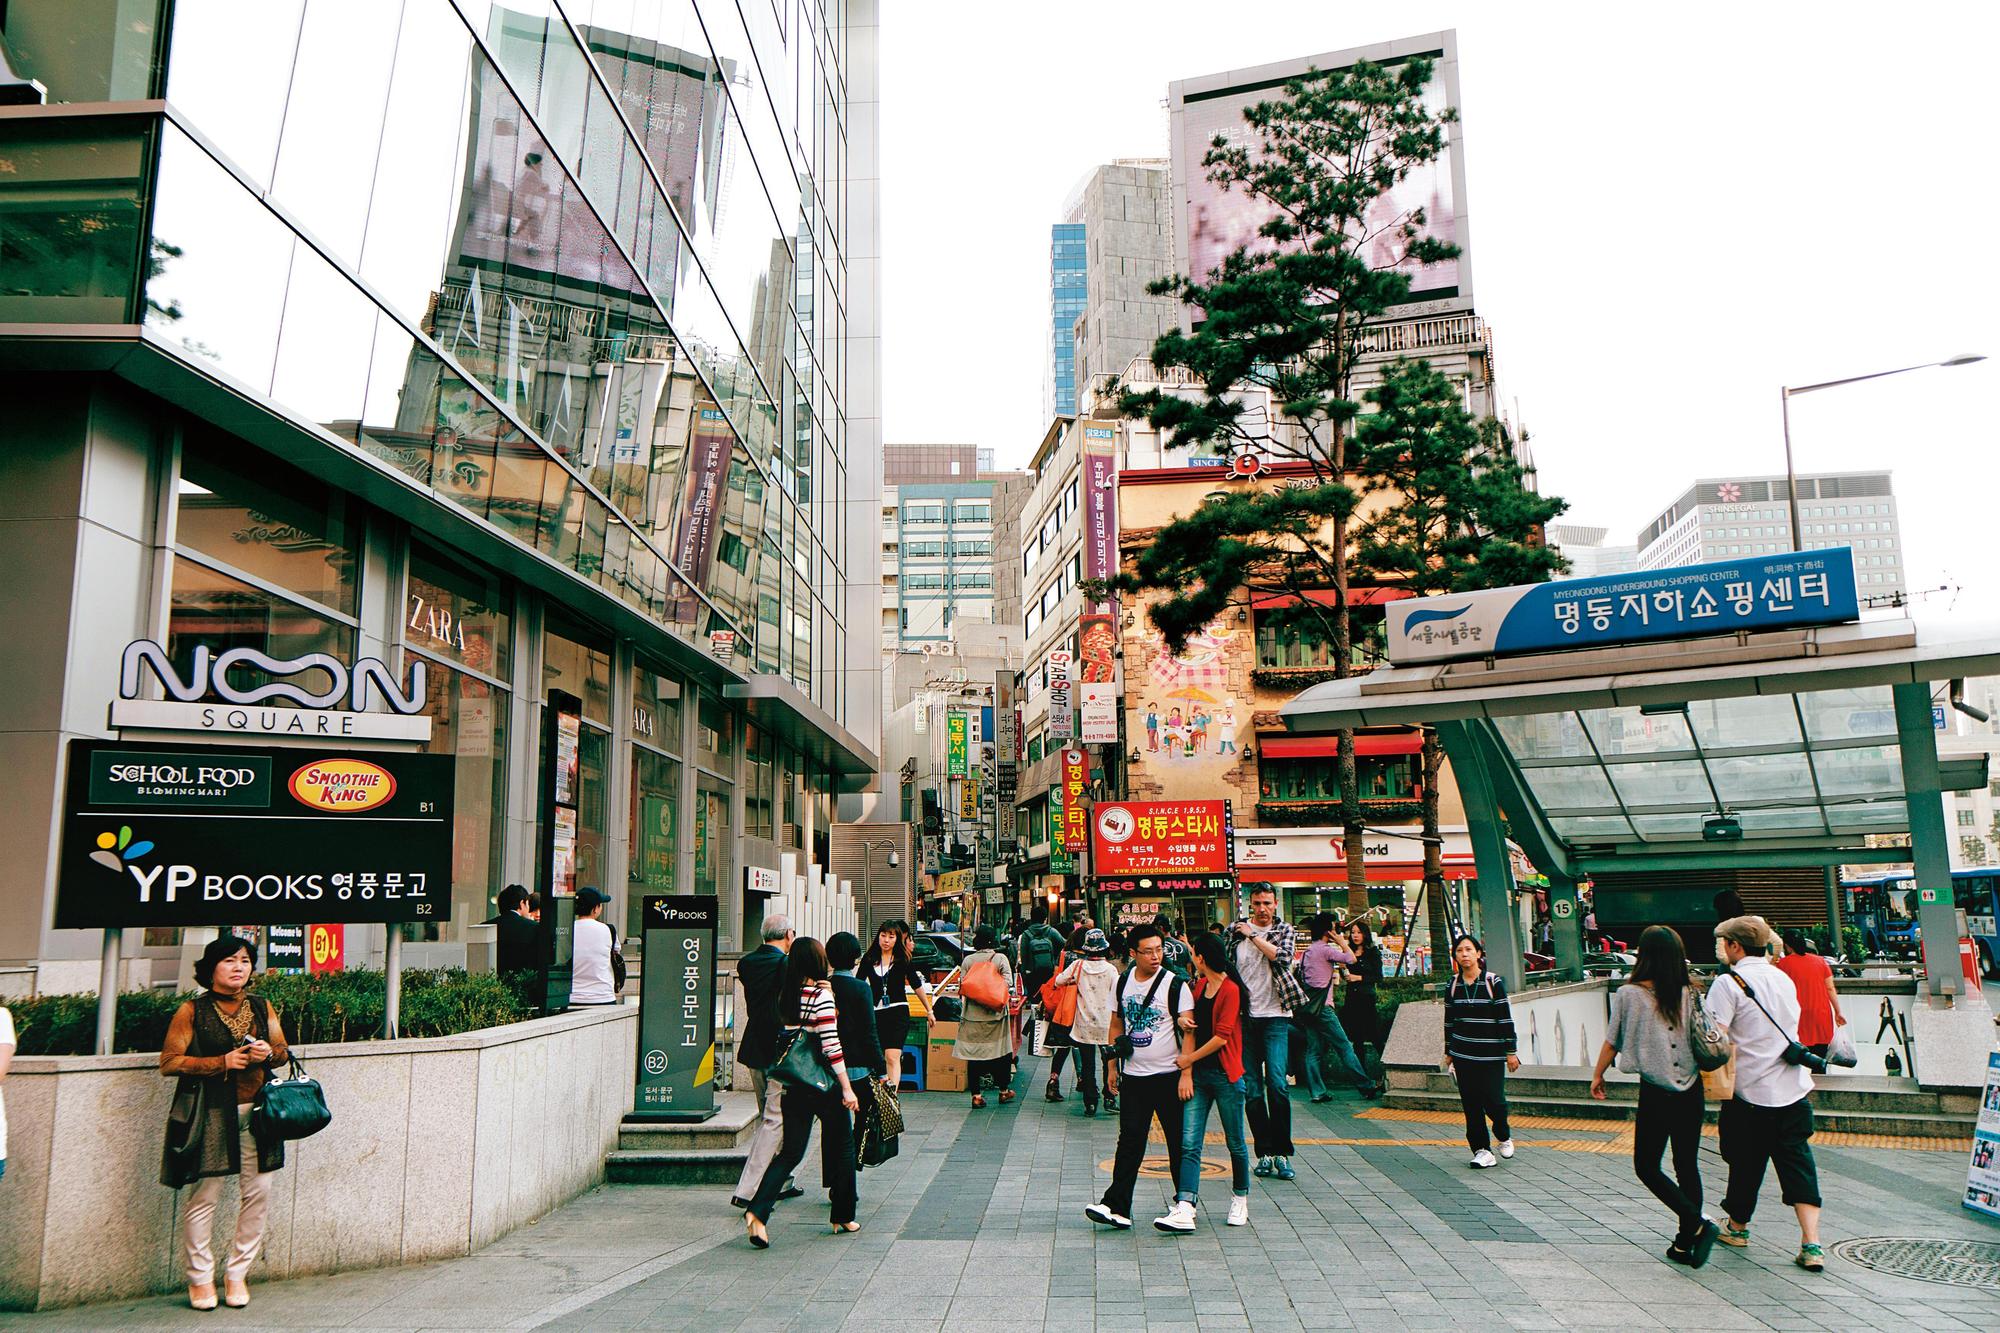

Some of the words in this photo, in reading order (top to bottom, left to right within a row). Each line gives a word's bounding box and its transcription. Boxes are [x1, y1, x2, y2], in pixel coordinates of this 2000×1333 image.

[1193, 459, 1220, 467] SINCE
[1553, 585, 1607, 600] MYEONGDONG
[1608, 578, 1668, 593] UNDERGROUND
[1669, 574, 1709, 586] SHOPPING
[1710, 570, 1740, 581] CENTER
[1554, 572, 1830, 634] 명동지하쇼핑센터
[408, 594, 466, 651] ZARA
[1411, 621, 1482, 646] 서울시설공단
[121, 639, 427, 714] NOON
[1050, 653, 1071, 708] STARSHOT
[202, 708, 354, 735] SQUARE
[632, 706, 654, 736] ARA
[951, 719, 965, 759] 명동사
[109, 764, 194, 784] SCHOOL
[197, 766, 255, 787] FOOD
[305, 768, 380, 786] SMOOTHIE
[320, 786, 367, 804] KING
[420, 802, 434, 812] B1
[1137, 815, 1219, 840] 명동스타사
[1199, 844, 1216, 852] A/S
[1362, 843, 1388, 856] orld
[1113, 866, 1210, 875] www.myungdongstarsa.com
[1127, 856, 1195, 867] T.777-4203
[129, 865, 197, 902] YP
[203, 875, 323, 901] BOOKS
[331, 872, 427, 899] 영풍문고
[416, 904, 432, 915] B2
[662, 909, 678, 920] YP
[678, 911, 708, 920] BOOKS
[1555, 904, 1569, 914] 15
[270, 925, 296, 937] Welcome
[296, 926, 303, 937] to
[315, 934, 327, 952] B1
[680, 938, 700, 1047] 영풍문고
[648, 1056, 665, 1069] B2
